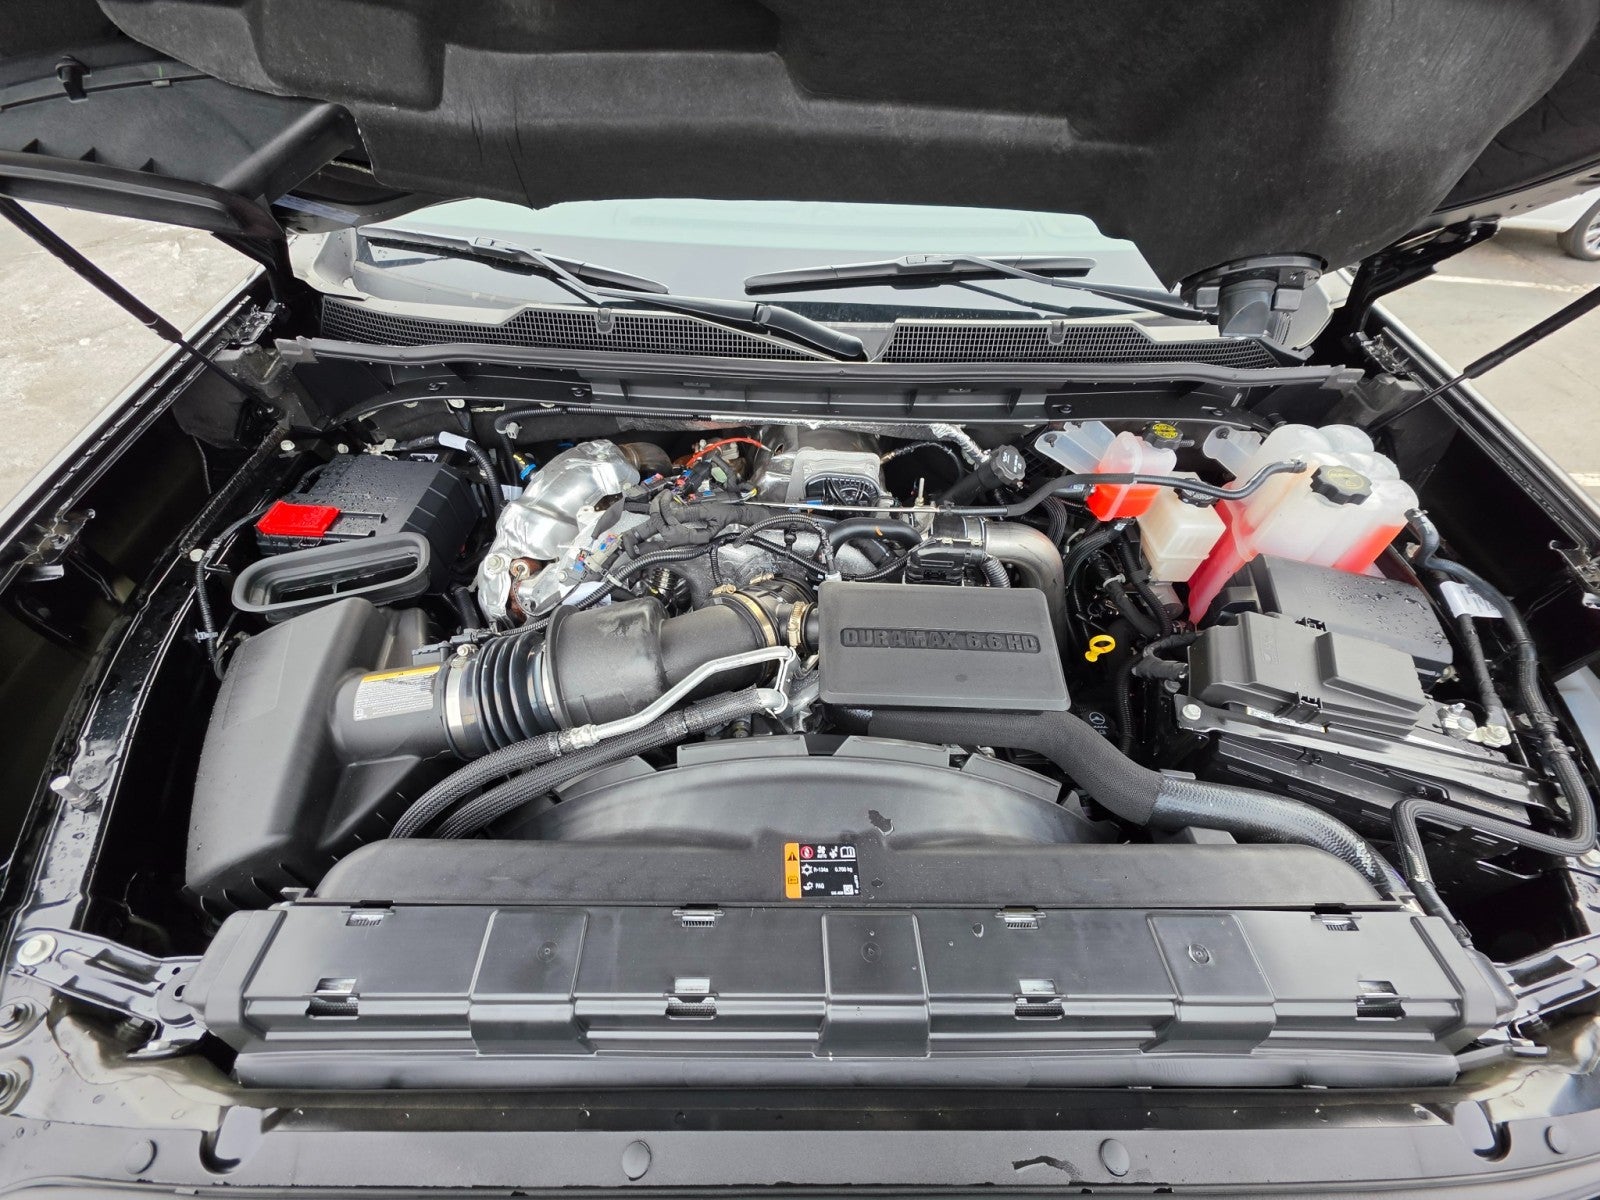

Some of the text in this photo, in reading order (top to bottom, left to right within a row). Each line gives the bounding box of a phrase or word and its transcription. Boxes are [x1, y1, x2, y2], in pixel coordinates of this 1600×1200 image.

[843, 629, 1038, 651] DURAMAX 6.6 HD
